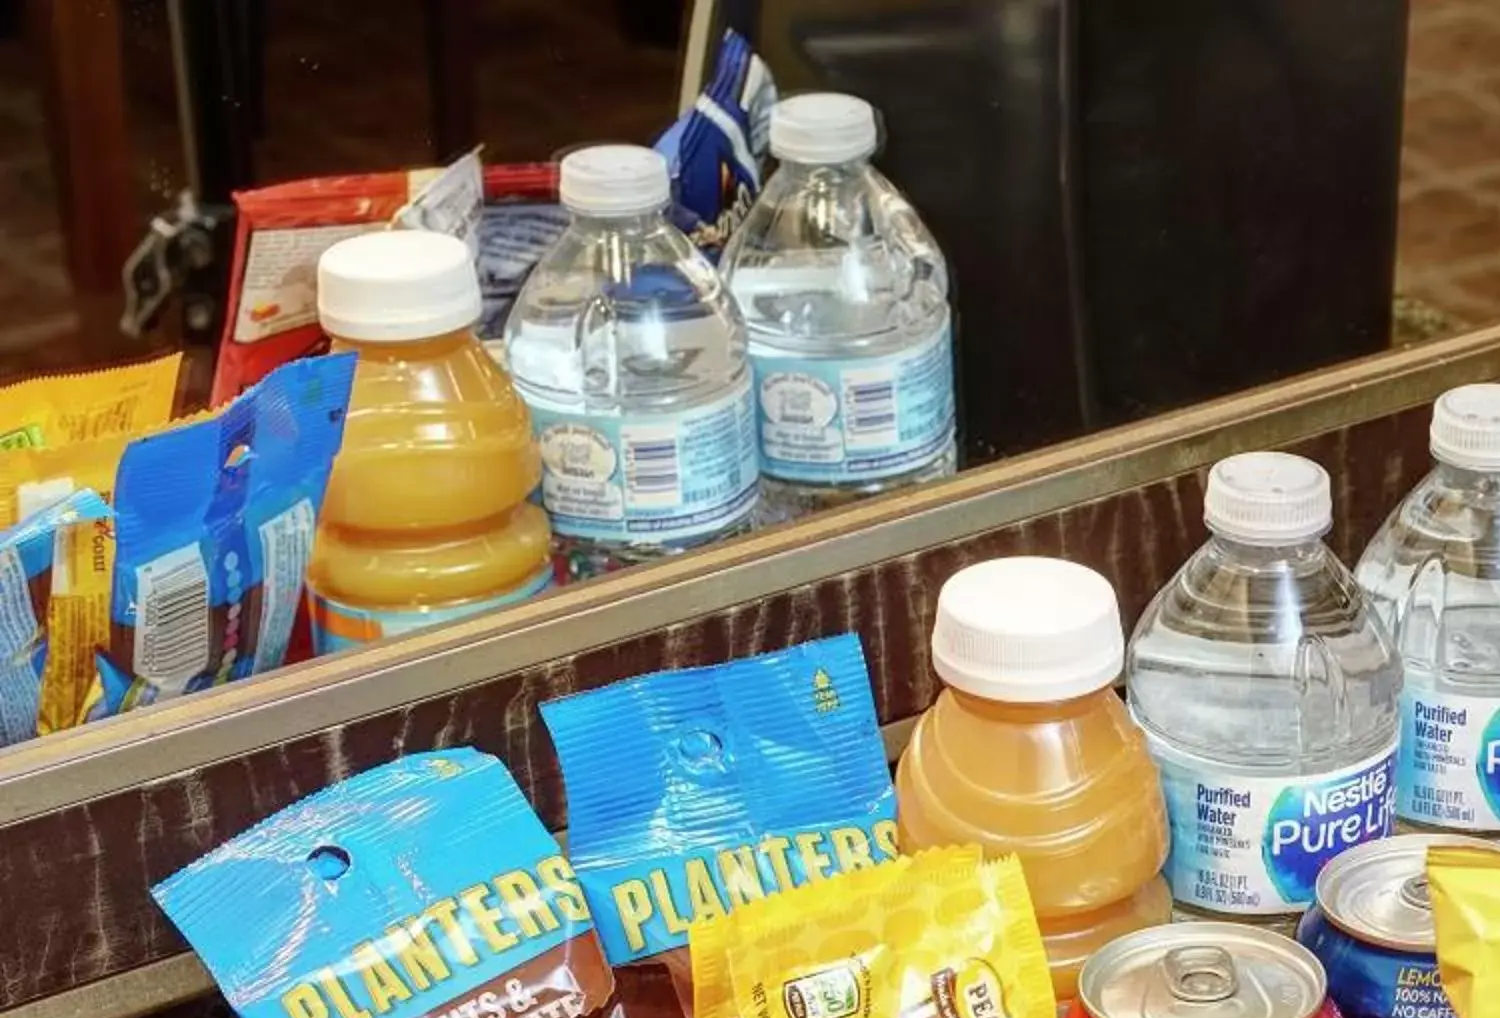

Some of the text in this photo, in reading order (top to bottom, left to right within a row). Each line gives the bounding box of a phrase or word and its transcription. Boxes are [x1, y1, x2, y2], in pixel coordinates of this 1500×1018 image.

[1415, 702, 1468, 726] Purified
[1415, 722, 1453, 743] Water
[1197, 784, 1251, 809] Purified
[1303, 764, 1387, 819] Nestlé
[1197, 803, 1236, 827] Water
[1272, 813, 1361, 857] Pure
[611, 819, 900, 953] PLANTERS
[504, 978, 538, 1013] &
[1395, 987, 1432, 1004] 100%
[1391, 1003, 1416, 1018] NO
